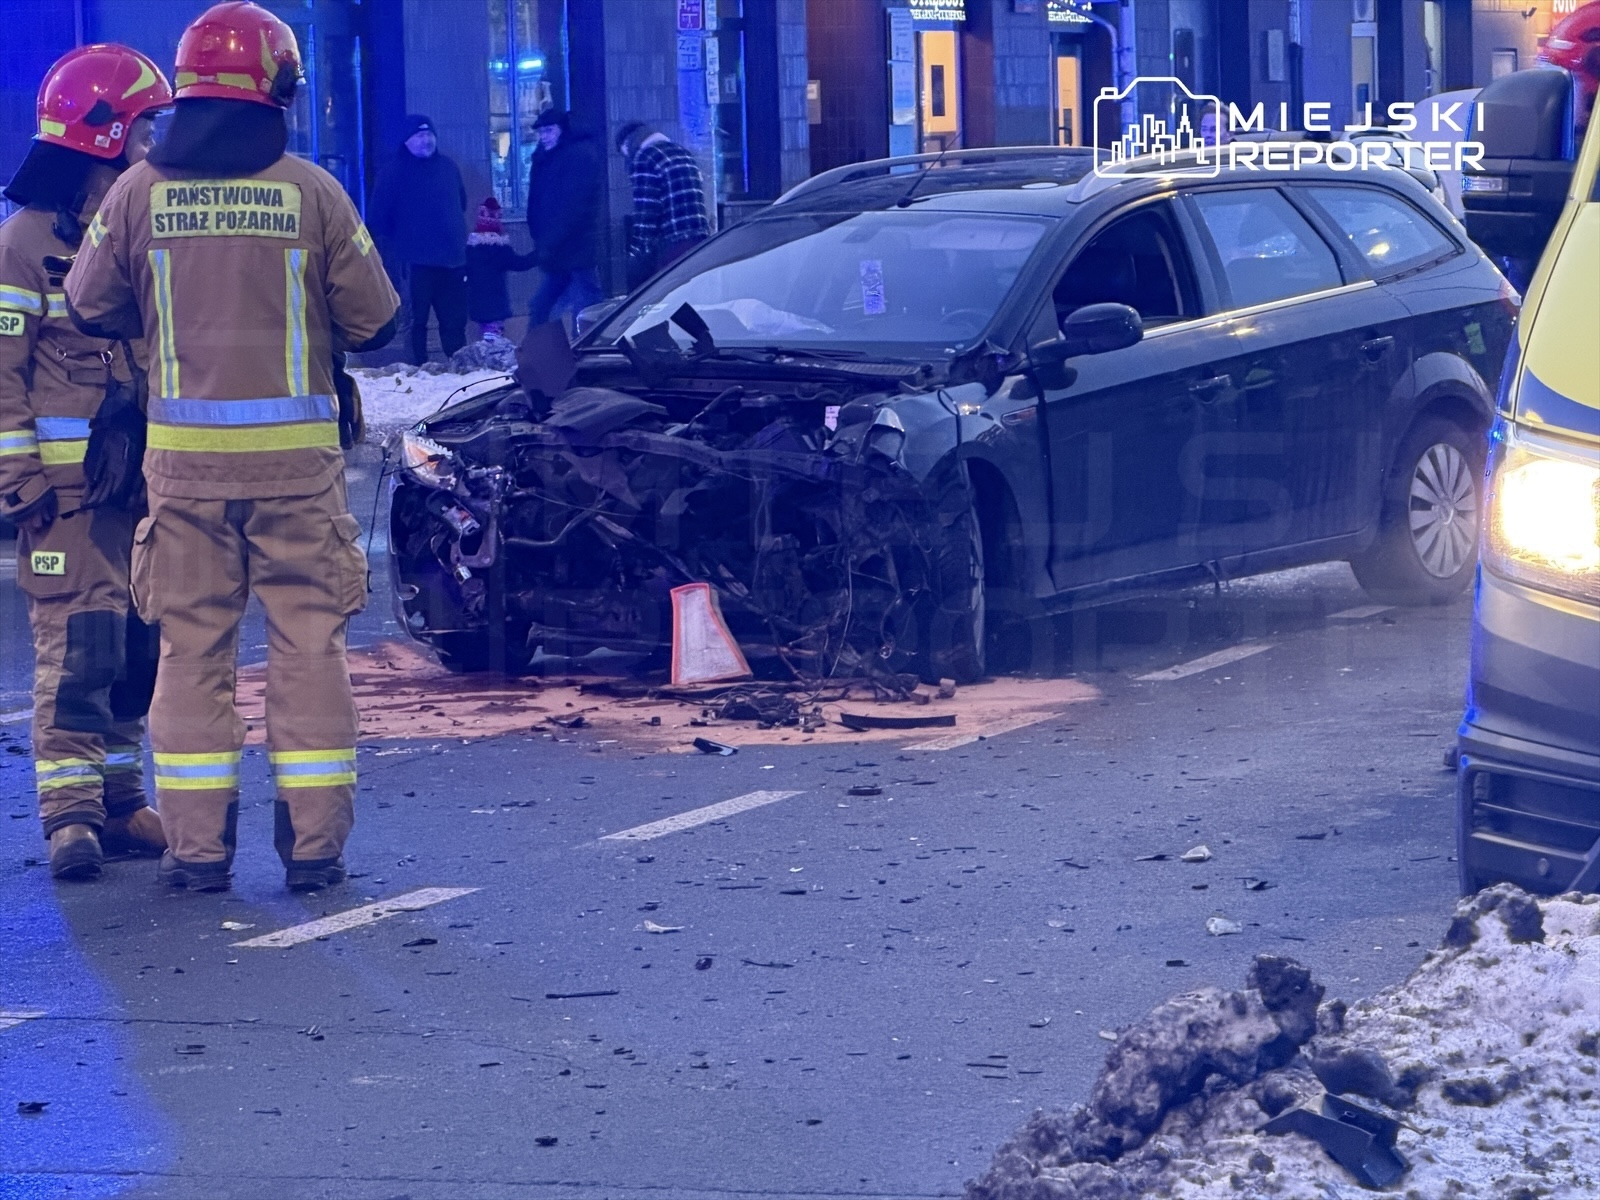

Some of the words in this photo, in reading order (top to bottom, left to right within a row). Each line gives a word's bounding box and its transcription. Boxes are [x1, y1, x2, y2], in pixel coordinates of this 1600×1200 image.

[109, 121, 124, 140] 8
[166, 183, 284, 208] PAŃSTWOWA
[0, 316, 20, 331] SP
[34, 555, 59, 571] PSP
